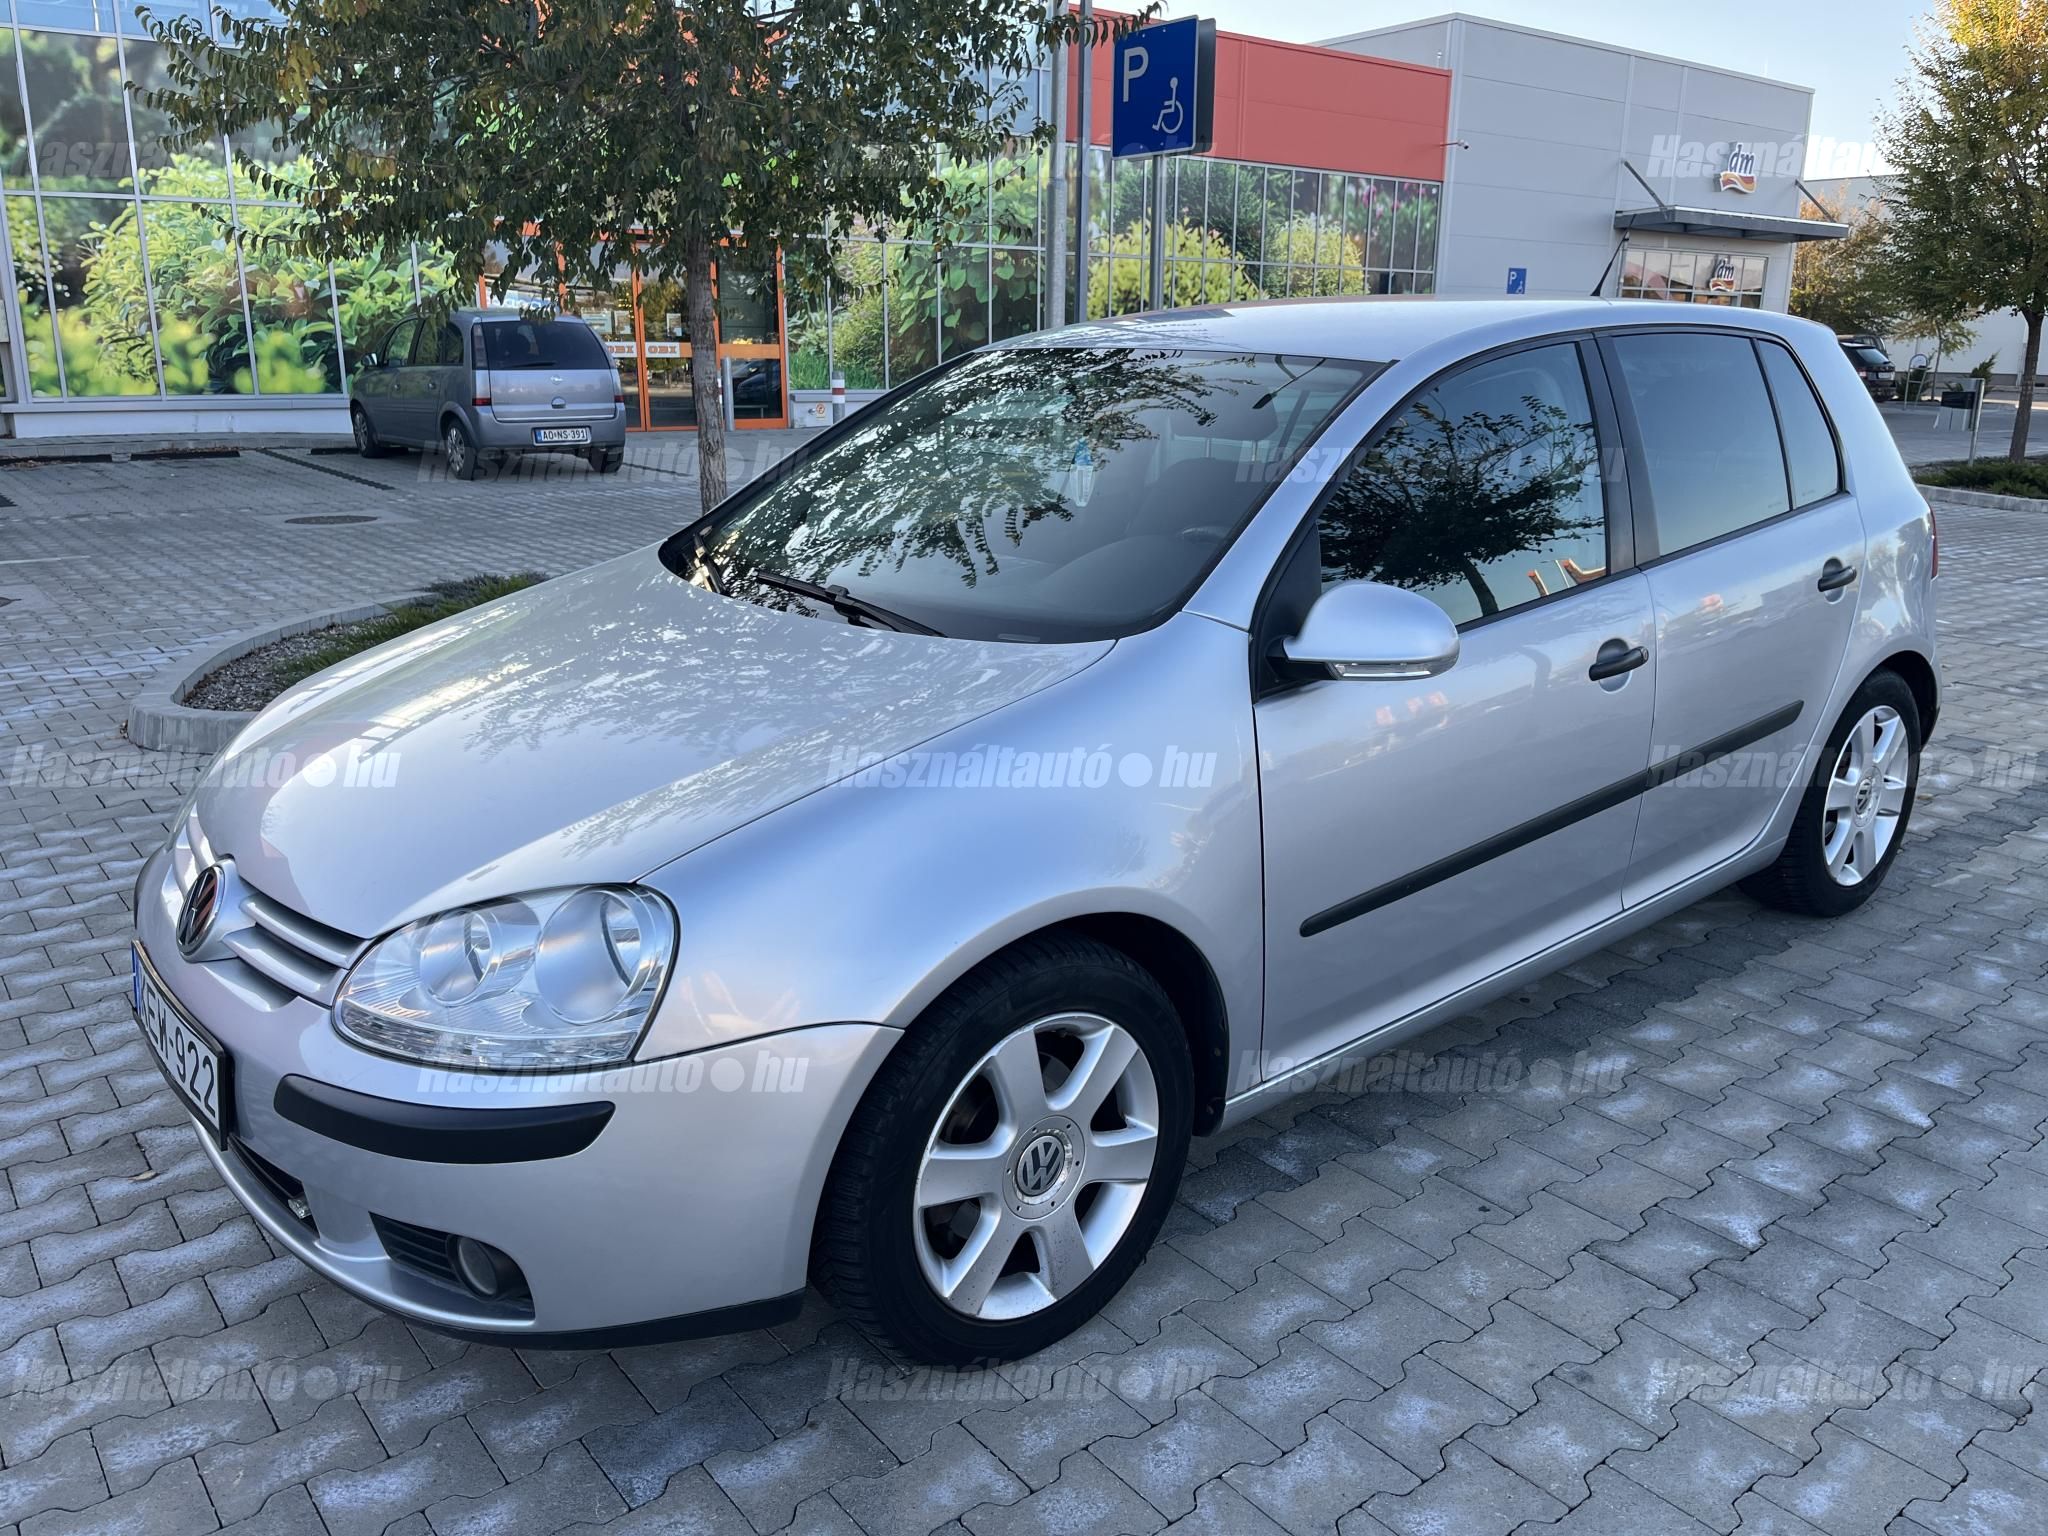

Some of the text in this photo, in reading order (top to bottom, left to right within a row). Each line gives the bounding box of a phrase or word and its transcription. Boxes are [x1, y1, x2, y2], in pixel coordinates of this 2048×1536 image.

[1123, 46, 1149, 102] P
[1509, 271, 1518, 286] P
[647, 345, 677, 354] OBI
[1018, 1136, 1065, 1195] VW
